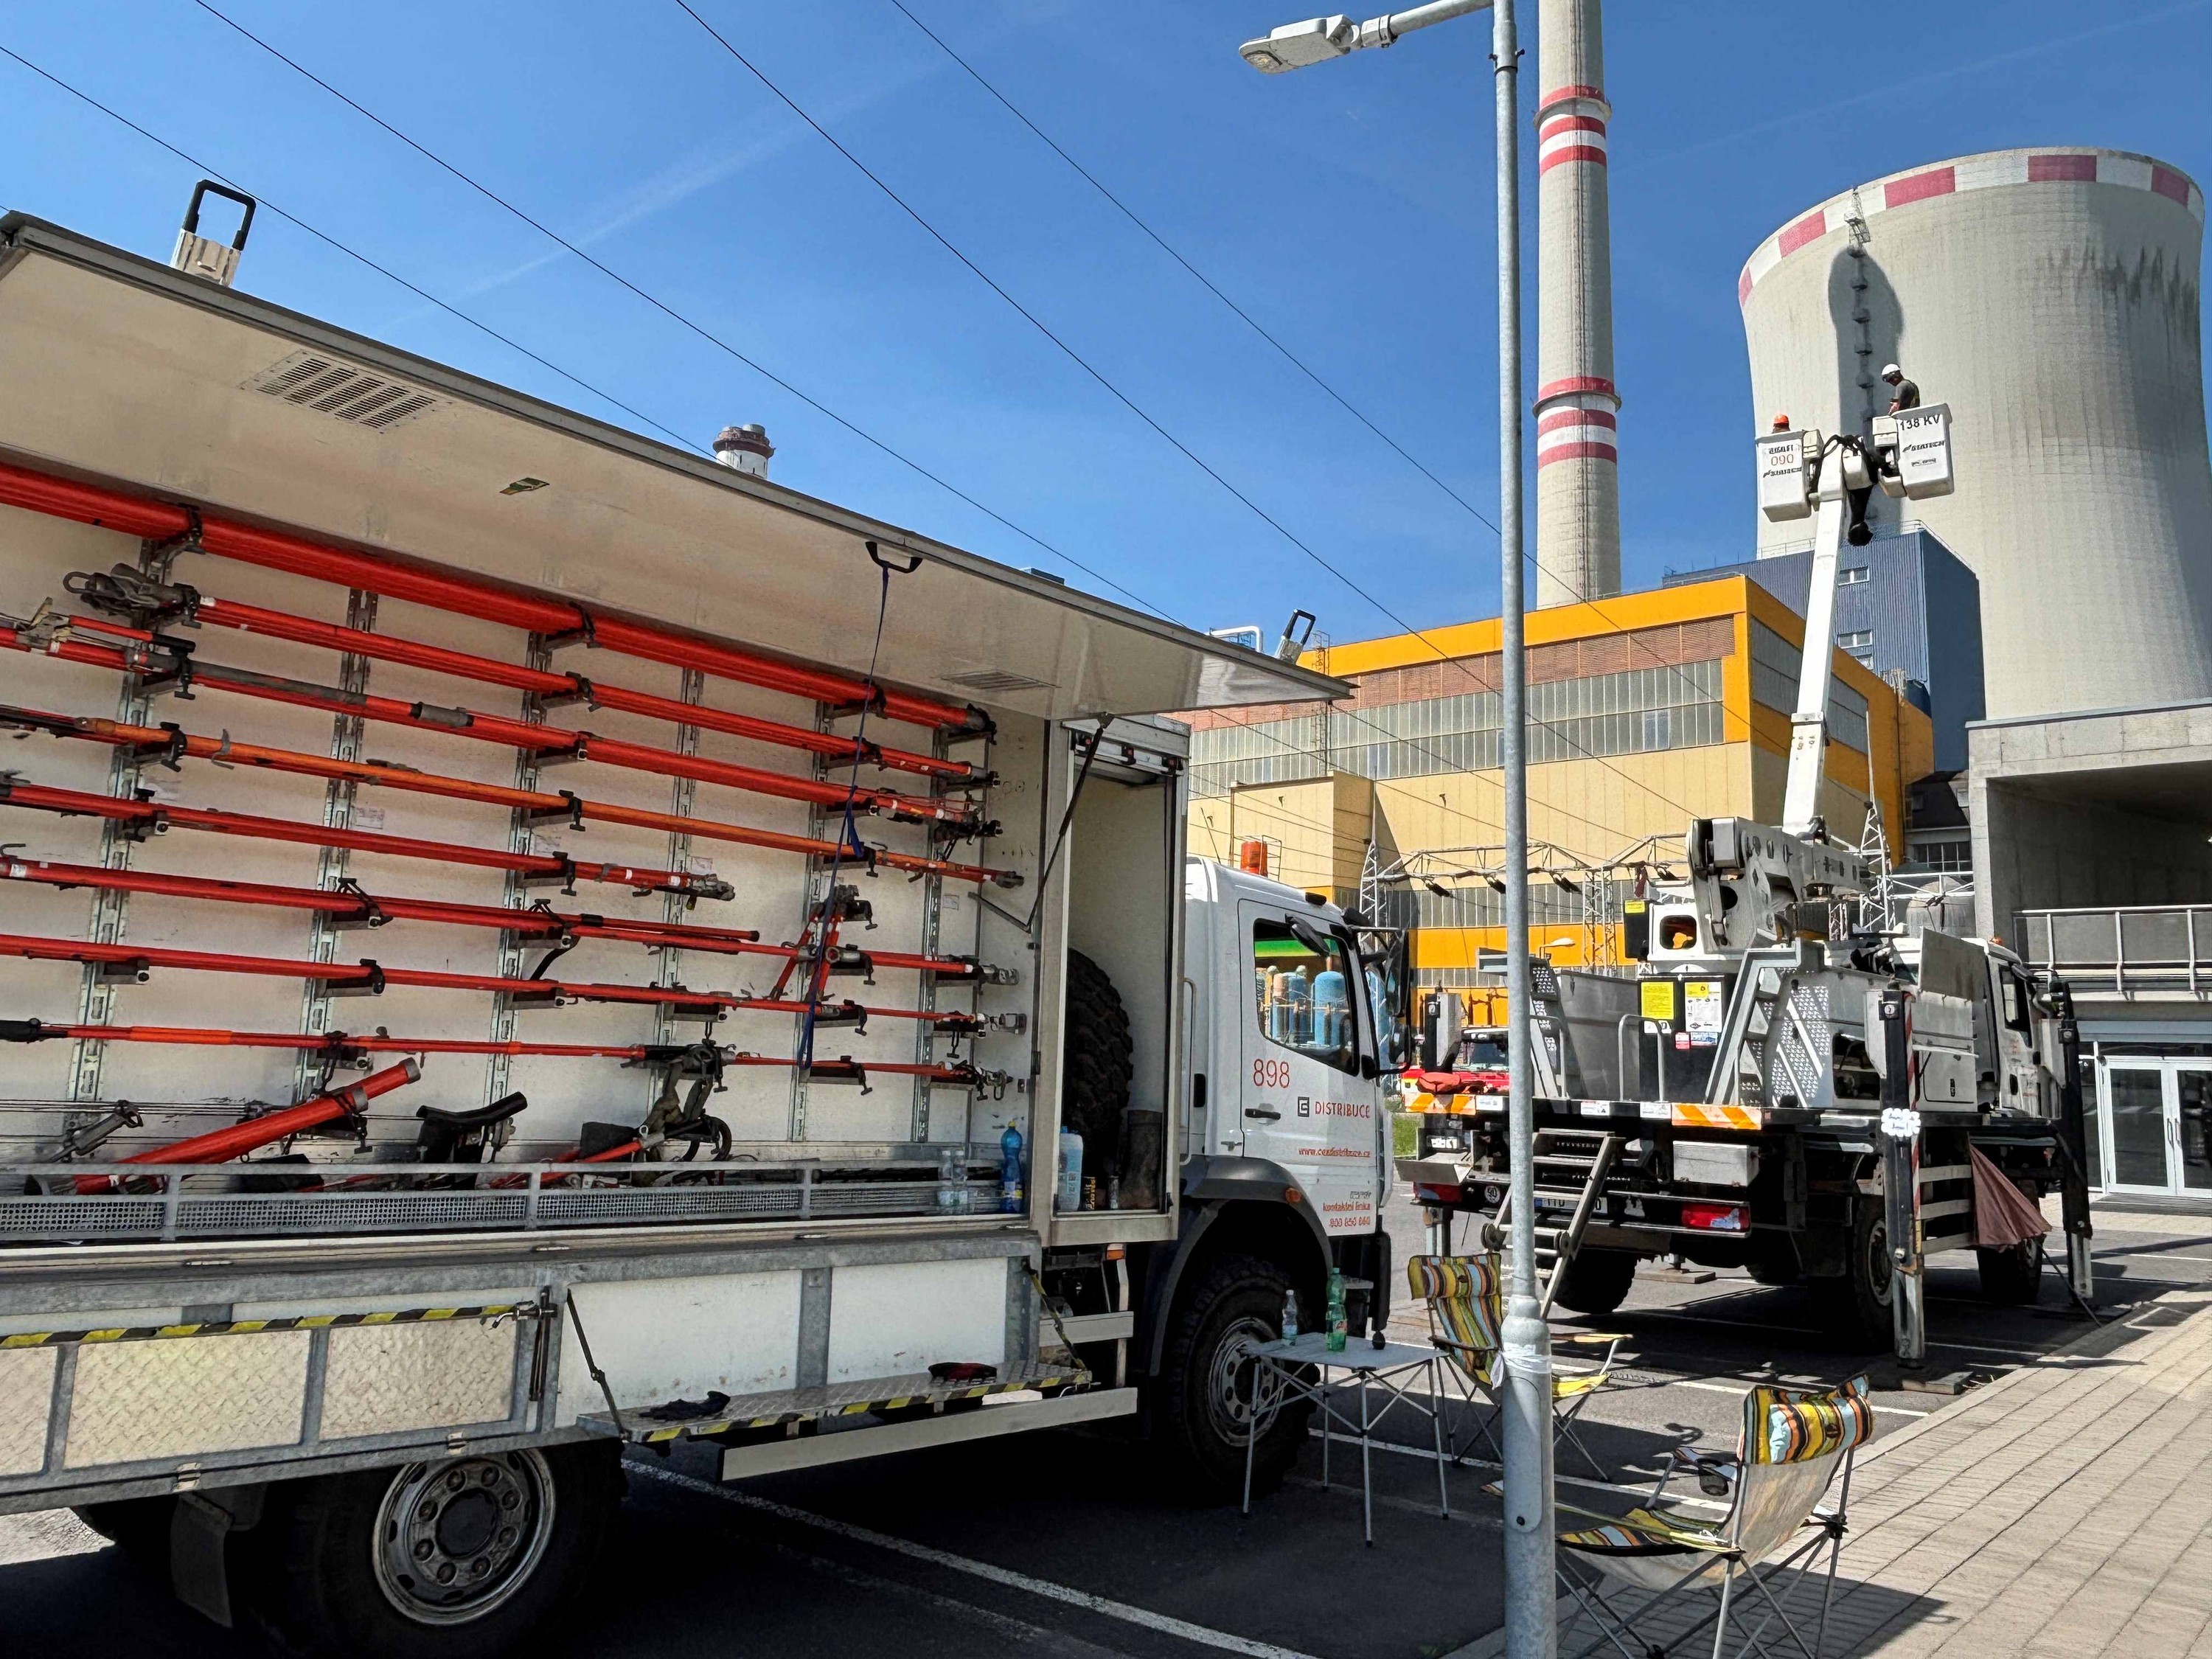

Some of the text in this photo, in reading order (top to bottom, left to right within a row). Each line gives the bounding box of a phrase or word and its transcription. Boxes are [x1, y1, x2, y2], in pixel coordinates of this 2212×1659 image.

[1900, 414, 1940, 431] 138 KV
[1771, 453, 1794, 466] 090
[1253, 1058, 1290, 1089] 898
[1315, 1102, 1371, 1119] DISTRIBUCE
